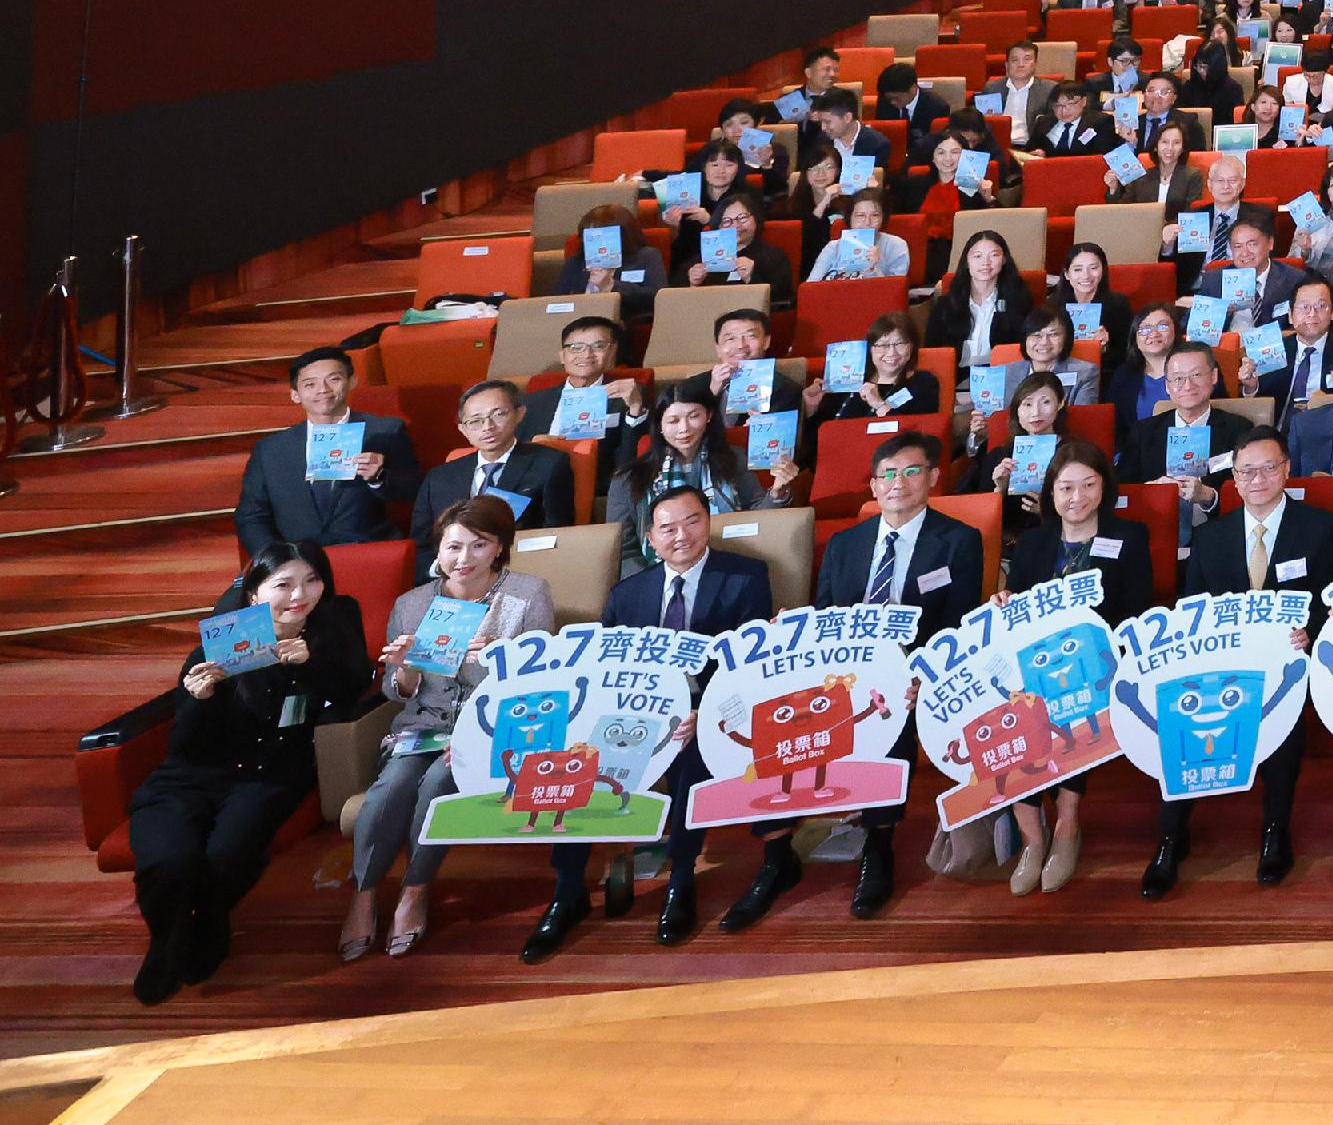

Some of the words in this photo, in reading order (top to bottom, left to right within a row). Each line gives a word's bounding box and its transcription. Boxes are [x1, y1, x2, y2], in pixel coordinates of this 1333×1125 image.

[714, 613, 808, 671] 12.7
[815, 608, 917, 644] 齊投票
[910, 609, 993, 684] 12.7
[1002, 574, 1098, 631] 齊投票
[1119, 599, 1206, 657] 12.7
[1214, 595, 1307, 628] 齊投票
[486, 630, 595, 681] 12.7
[598, 630, 708, 669] 齊投票
[762, 650, 814, 678] LET'S
[821, 647, 874, 664] VOTE
[1137, 644, 1186, 675] LET'S
[1189, 633, 1241, 655] VOTE
[602, 671, 660, 690] LET'S
[923, 667, 973, 712] LET'S
[617, 693, 674, 715] VOTE
[933, 680, 986, 724] VOTE
[776, 731, 830, 758] 投票箱
[982, 736, 1027, 766] 投票箱
[1182, 764, 1235, 785] 投票箱
